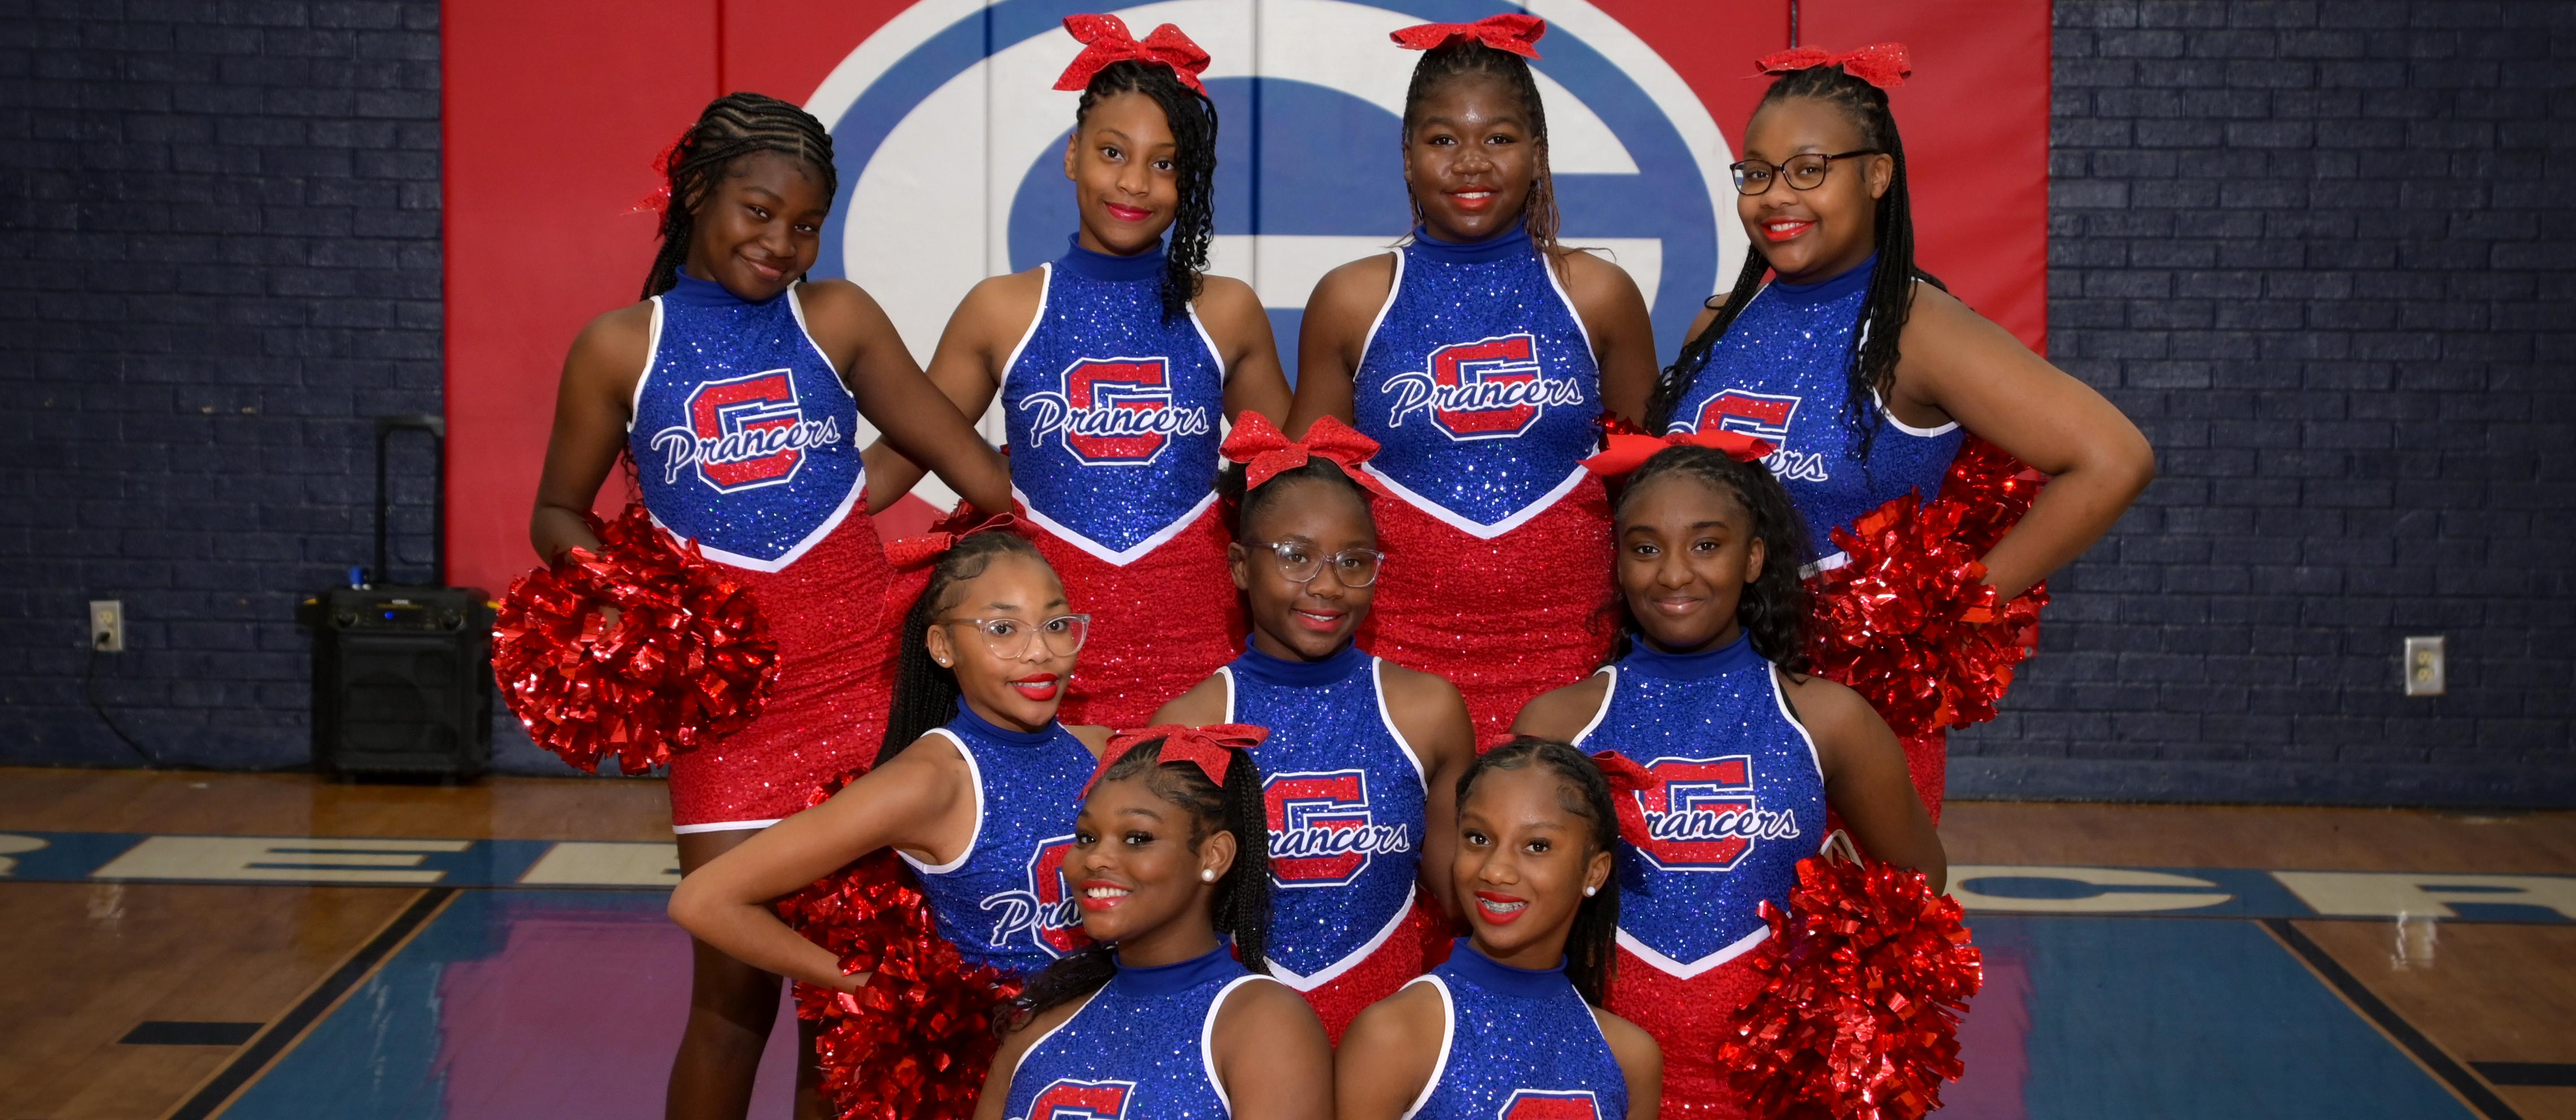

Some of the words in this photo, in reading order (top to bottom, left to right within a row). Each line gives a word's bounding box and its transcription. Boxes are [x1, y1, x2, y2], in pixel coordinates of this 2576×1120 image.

[684, 368, 806, 494] G
[1019, 391, 1210, 447] Prancers
[1060, 356, 1172, 465] G
[1382, 372, 1584, 428] Prancers
[1427, 333, 1542, 441] G
[651, 415, 841, 484] Prancers
[1261, 769, 1371, 882] G
[1267, 823, 1410, 858] rancers
[1635, 755, 1755, 871] G
[1644, 808, 1800, 840] rancers
